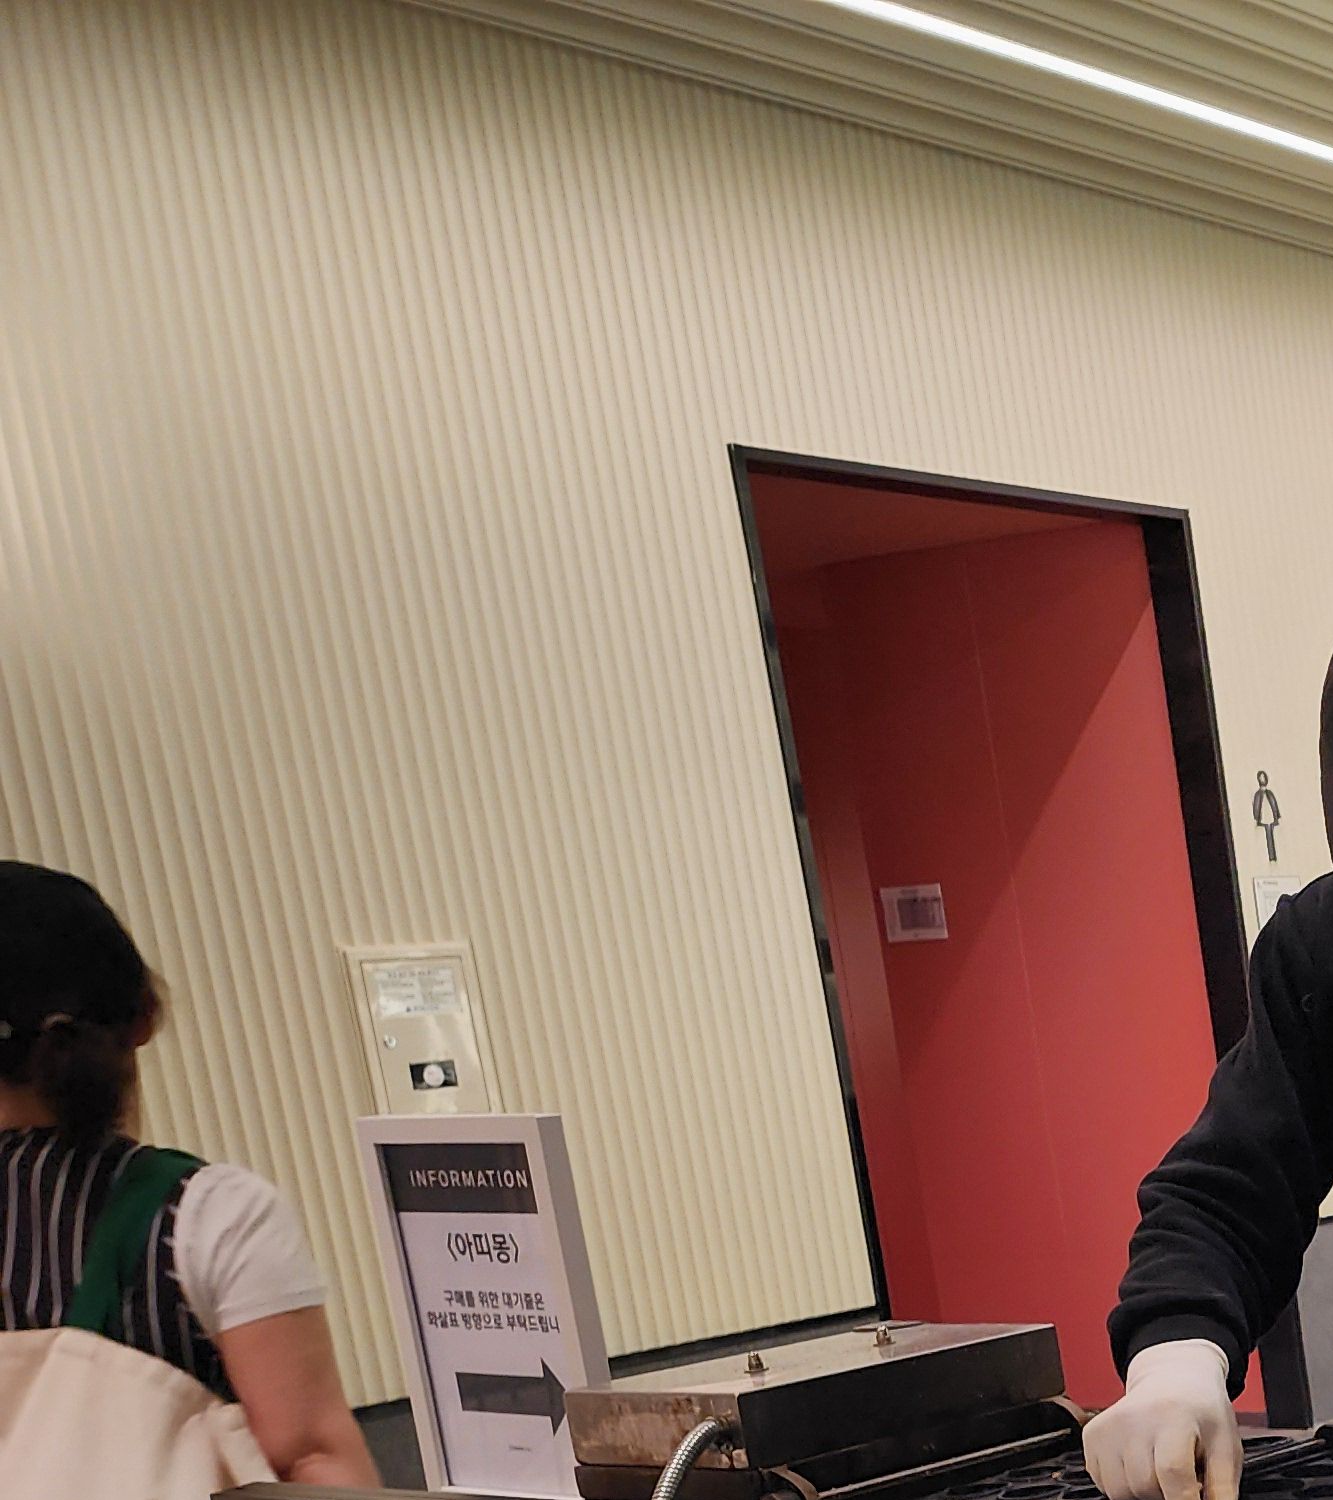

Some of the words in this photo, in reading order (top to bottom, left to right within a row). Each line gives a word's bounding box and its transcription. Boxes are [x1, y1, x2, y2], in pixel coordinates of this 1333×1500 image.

[409, 1168, 528, 1189] INFORMATION
[478, 1291, 499, 1309] 위한
[427, 1311, 459, 1329] 화살표
[461, 1312, 504, 1331] 방향으로
